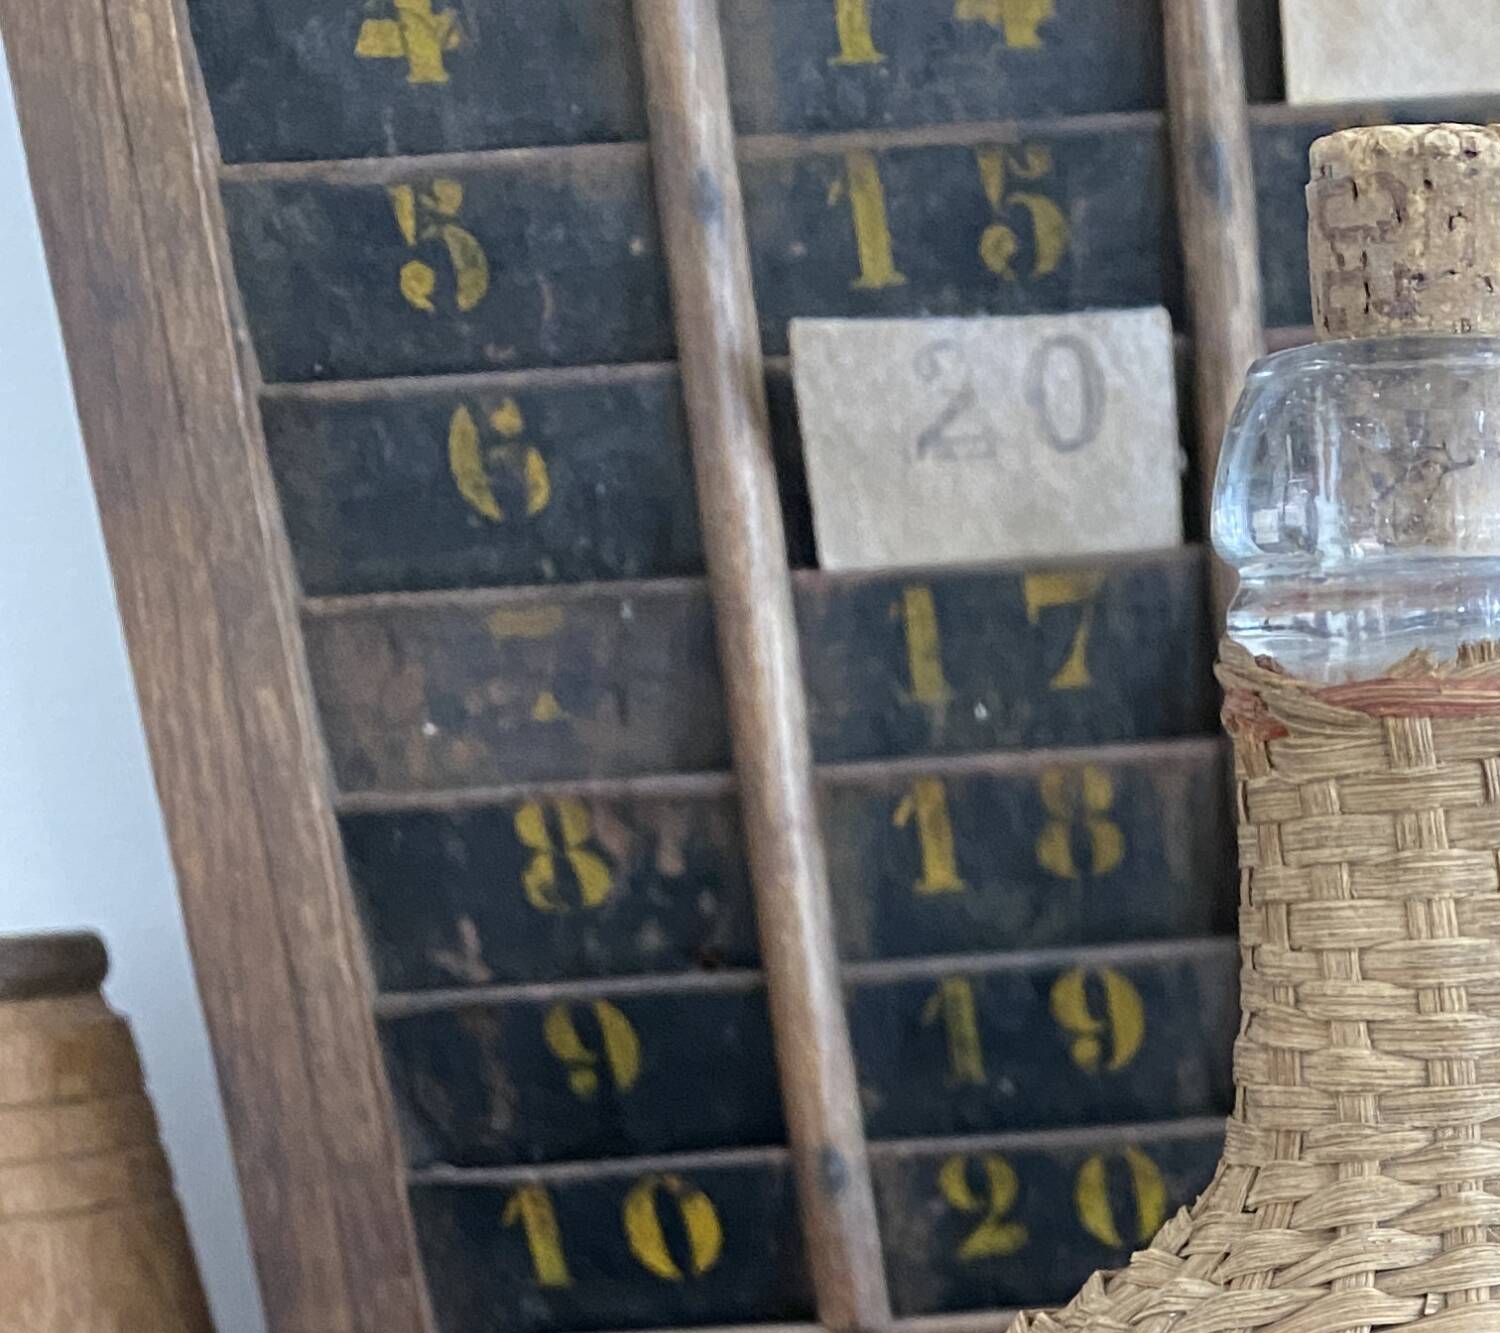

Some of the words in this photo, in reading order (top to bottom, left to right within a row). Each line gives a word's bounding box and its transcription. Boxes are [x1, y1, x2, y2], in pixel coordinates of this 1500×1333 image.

[355, 0, 463, 84] 4
[388, 179, 490, 311] 5
[827, 143, 1066, 289] 15
[913, 331, 1106, 464] 20
[447, 399, 552, 522] 6
[888, 569, 1105, 704] 17
[513, 796, 614, 914] 8
[893, 766, 1124, 896] 18
[544, 999, 642, 1099] 9
[922, 966, 1146, 1086] 19
[500, 1175, 724, 1289] 10
[936, 1146, 1167, 1262] 20
